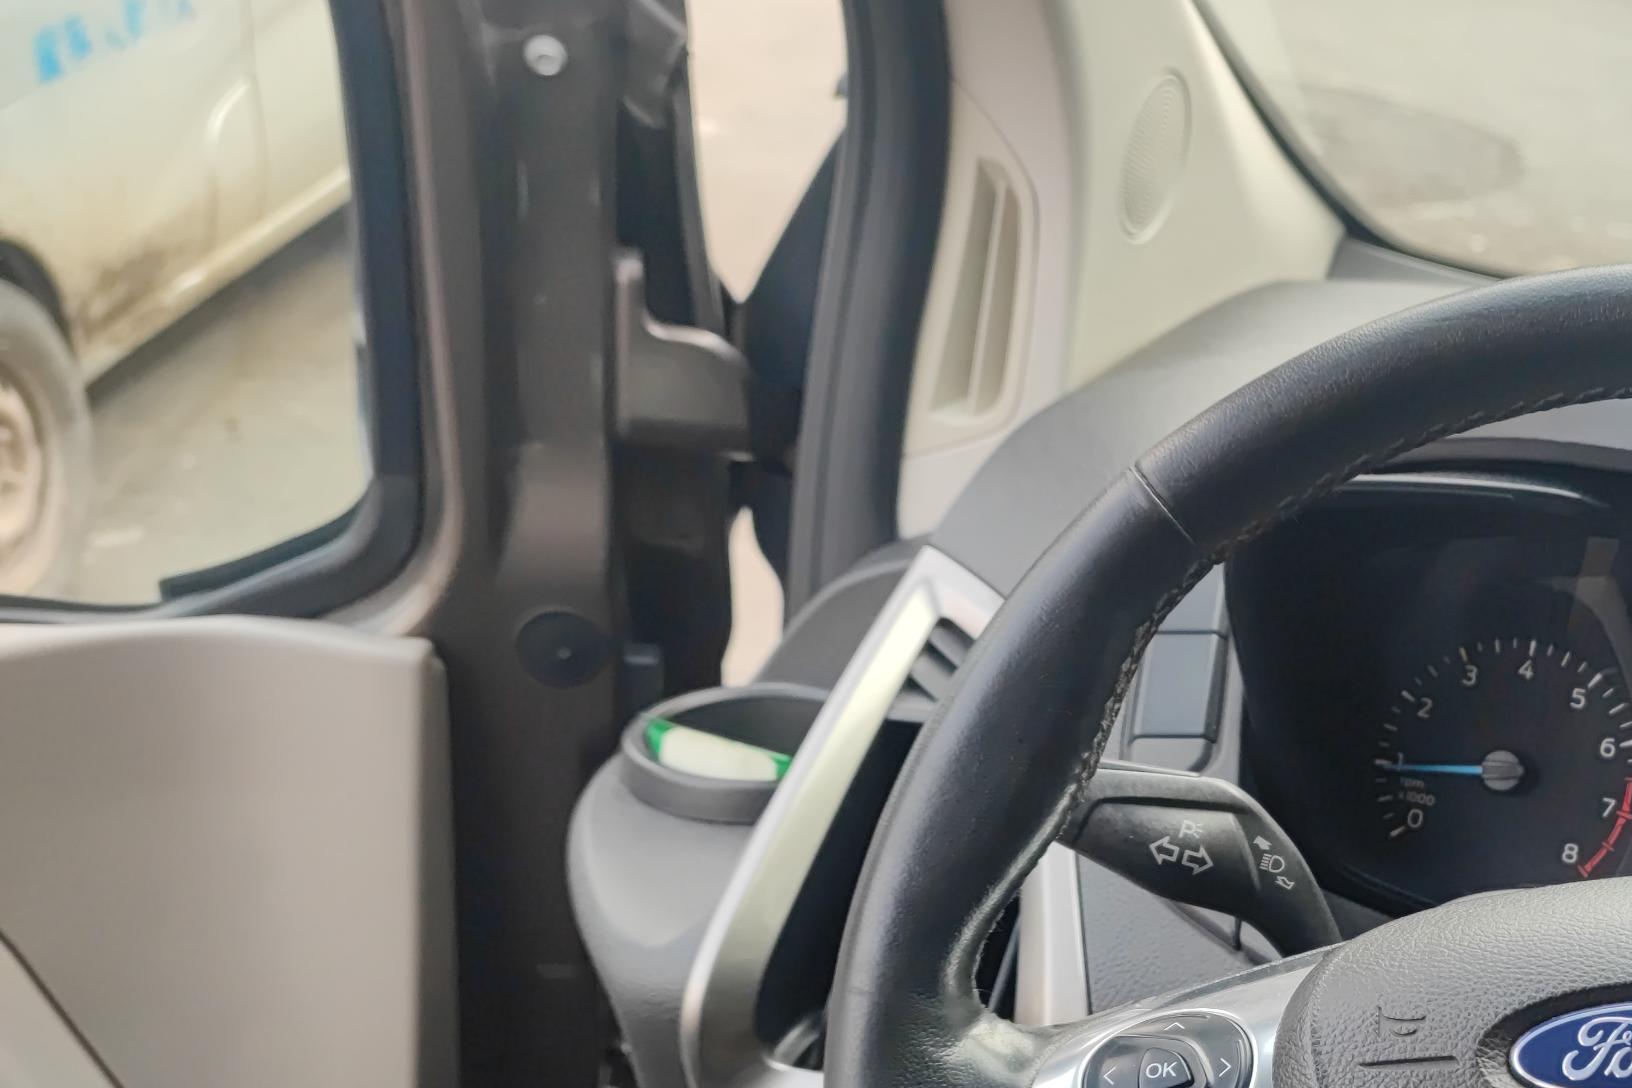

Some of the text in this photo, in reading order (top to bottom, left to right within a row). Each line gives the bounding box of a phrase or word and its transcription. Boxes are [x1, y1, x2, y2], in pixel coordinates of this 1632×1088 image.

[1462, 665, 1478, 686] 3
[1518, 659, 1534, 680] 4
[1416, 697, 1433, 719] 2
[1569, 687, 1587, 710] 5
[1599, 737, 1616, 758] 6
[1407, 808, 1424, 828] 0
[1602, 797, 1616, 818] 7
[1561, 843, 1579, 864] 8
[1145, 1060, 1178, 1079] OK
